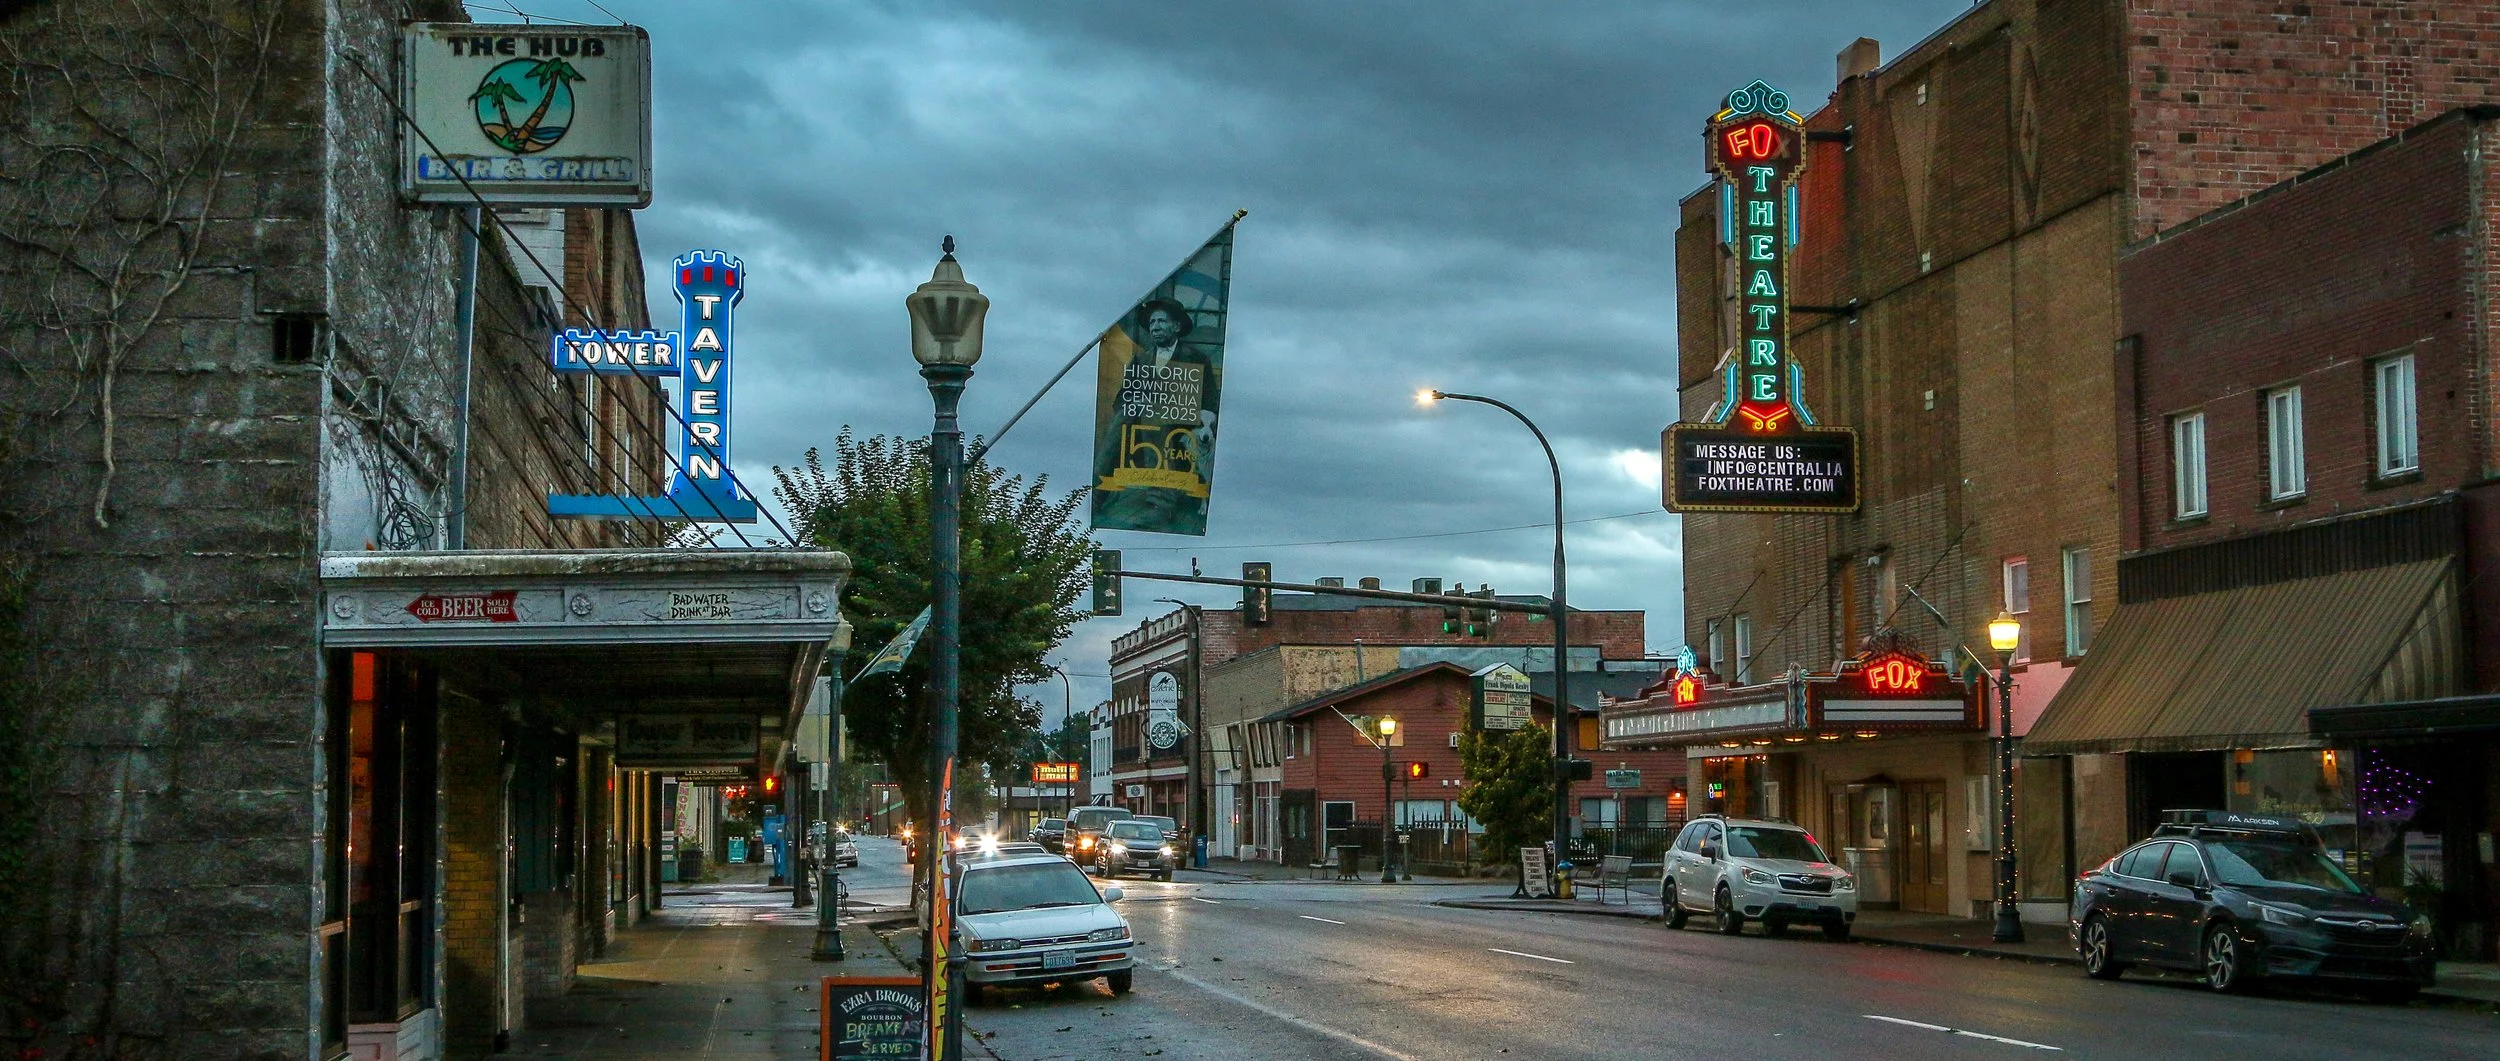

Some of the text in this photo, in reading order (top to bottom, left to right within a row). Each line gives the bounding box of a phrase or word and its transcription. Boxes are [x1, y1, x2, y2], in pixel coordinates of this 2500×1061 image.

[449, 36, 605, 57] THE HUB
[1727, 123, 1789, 159] FOX
[427, 157, 633, 181] BAR & GRILL
[1748, 164, 1778, 401] THEATRE
[564, 341, 673, 367] TOWER
[1123, 363, 1200, 382] HISTORIC
[688, 294, 724, 481] TAVERN
[1122, 379, 1200, 394] DOWNTOWN
[1122, 390, 1198, 408] CENTRALIA
[1121, 403, 1198, 422] 1875-2025
[1119, 423, 1198, 475] 150
[1695, 444, 1801, 459] MESSAGE US:
[1707, 461, 1843, 476] INFO@CENTRALIA
[1698, 476, 1834, 492] FOXTHEATRE.COM
[421, 600, 435, 608] ICE
[442, 598, 485, 618] BEER
[486, 599, 509, 607] SOLD
[673, 593, 729, 607] BAD WATER
[416, 607, 440, 616] COLD
[487, 607, 510, 615] HERE
[671, 607, 702, 619] DRINK
[711, 606, 732, 618] BAR
[1868, 660, 1922, 691] FOX
[1676, 679, 1695, 704] FOX
[2243, 818, 2279, 826] ARKSEN
[840, 989, 923, 1014] EZRA BROOKS
[846, 1020, 922, 1039] BREAKFAS
[860, 1038, 913, 1054] SERVED
